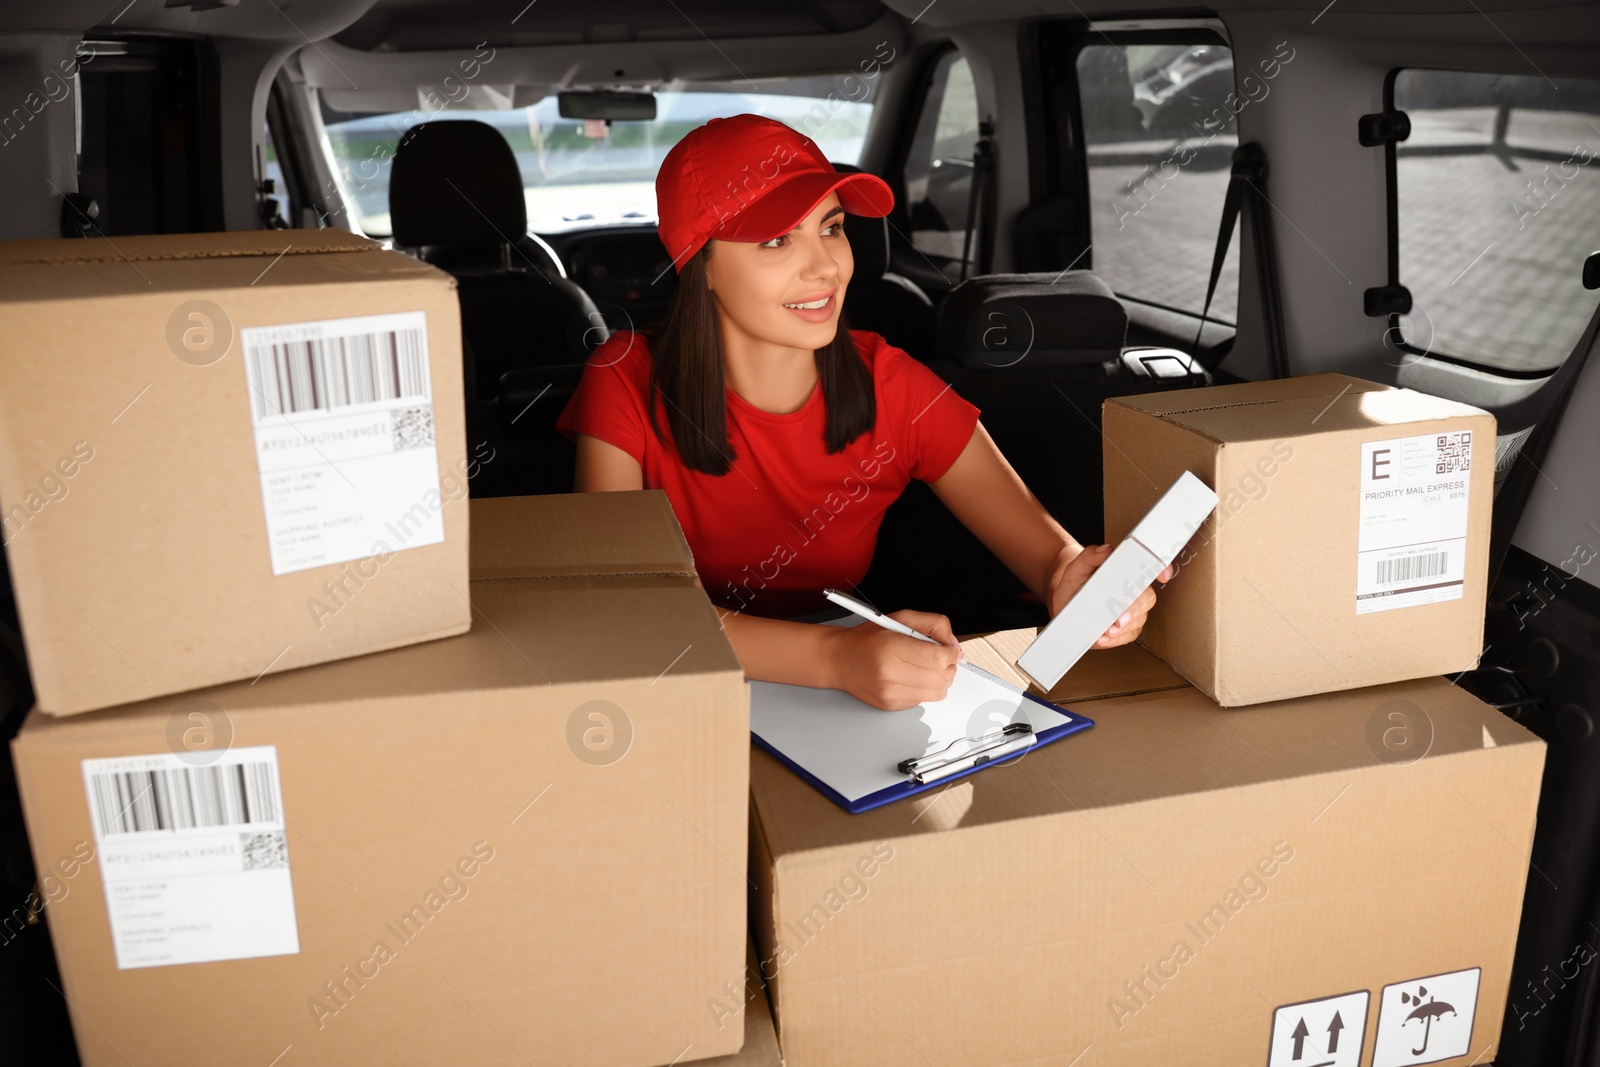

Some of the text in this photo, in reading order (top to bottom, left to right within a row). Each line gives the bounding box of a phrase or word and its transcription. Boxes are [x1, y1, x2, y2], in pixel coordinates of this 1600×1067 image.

[1371, 448, 1391, 481] E
[1364, 480, 1465, 501] PRIORITY MAIL EXPRESS
[1387, 550, 1407, 558] PRIORITY
[1418, 546, 1438, 554] EXPRESS
